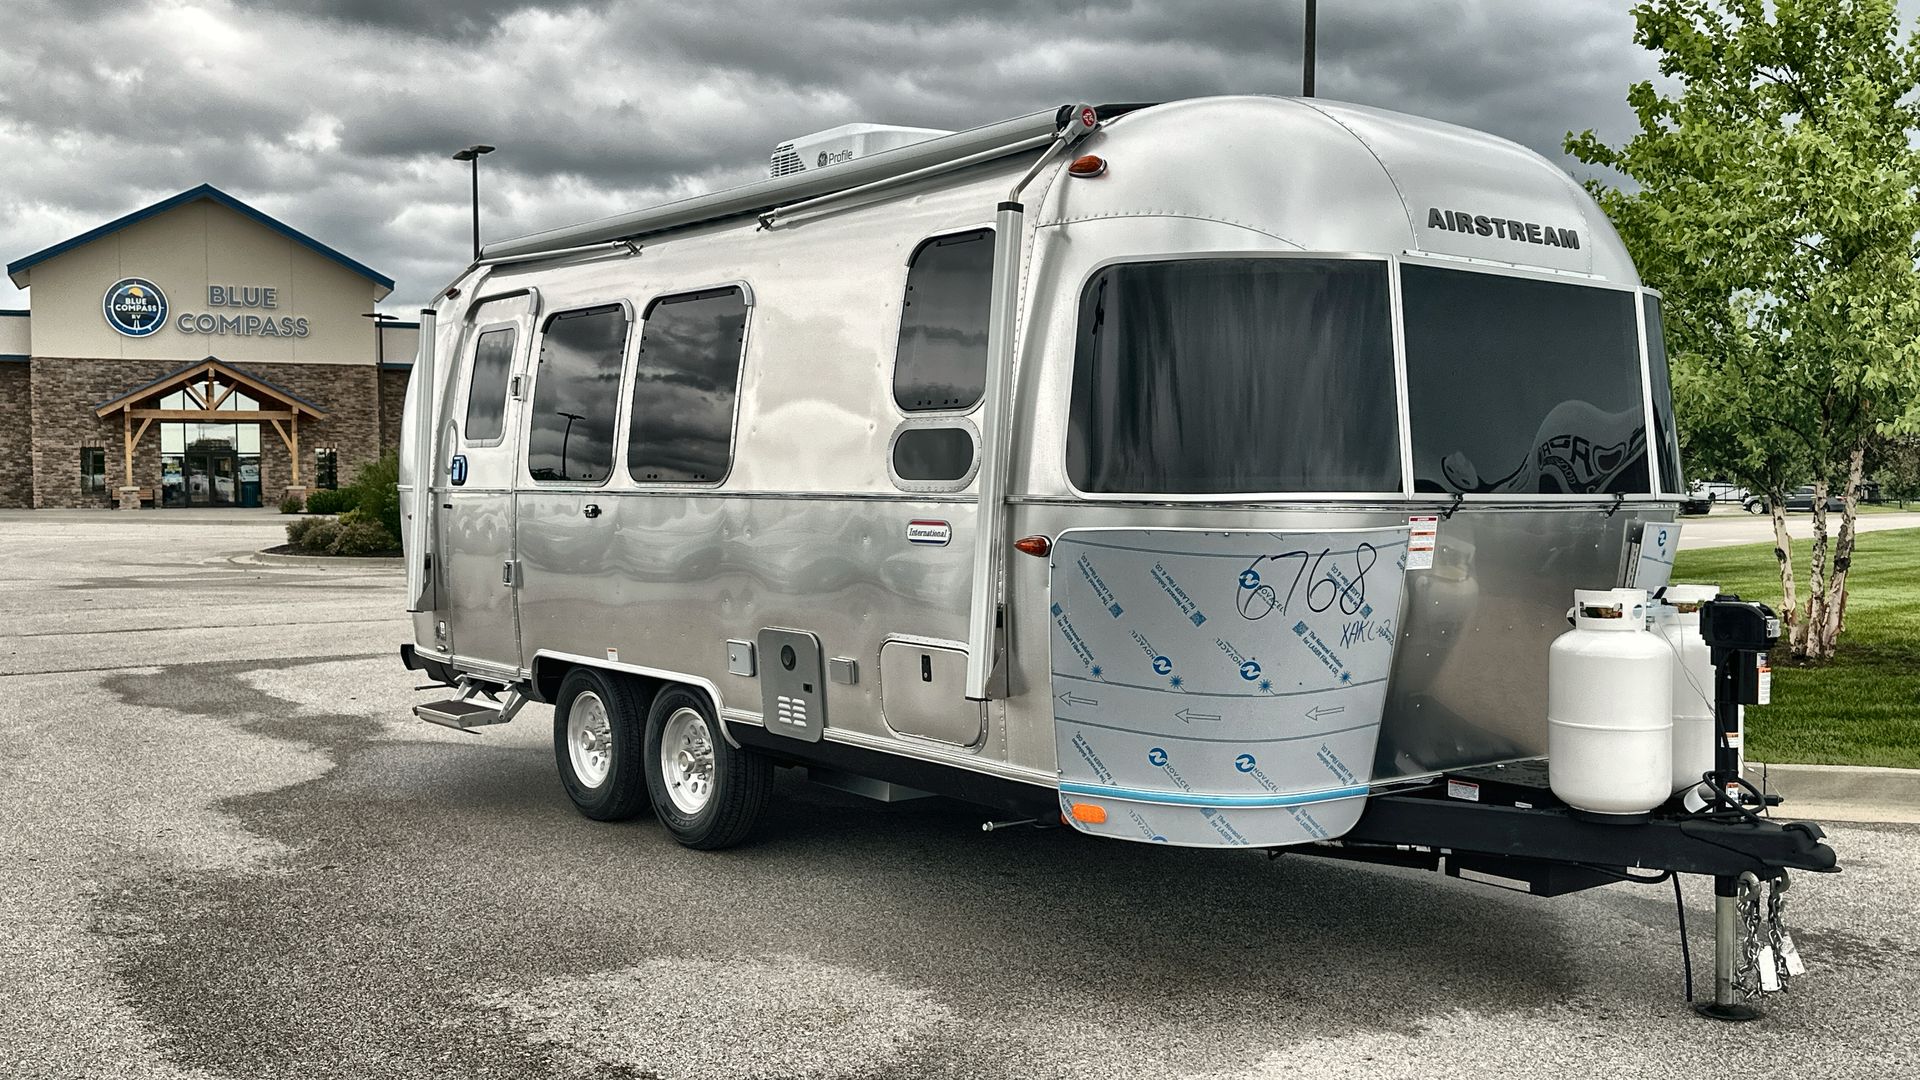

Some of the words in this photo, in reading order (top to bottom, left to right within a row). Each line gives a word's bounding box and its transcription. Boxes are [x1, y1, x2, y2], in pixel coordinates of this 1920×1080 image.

[828, 149, 853, 164] Profile
[1427, 207, 1581, 250] AIRSTREAM
[207, 284, 277, 308] BLUE
[115, 303, 158, 312] COMPASS
[176, 312, 310, 338] COMPASS
[909, 527, 948, 538] International
[1089, 567, 1098, 579] Fiber
[1151, 569, 1167, 588] Solution
[1165, 576, 1176, 588] Fiber
[1236, 542, 1377, 620] 6768
[1088, 579, 1102, 597] Novacel
[1096, 578, 1109, 594] LASER
[1175, 587, 1190, 602] LASER
[1165, 587, 1182, 606] Novacel
[1181, 605, 1189, 615] The
[1061, 626, 1073, 642] LASER
[1071, 642, 1081, 653] Fiber
[1067, 624, 1081, 642] Novacel
[1079, 641, 1094, 661] Solution
[1129, 630, 1158, 659] NOVACEL
[1216, 638, 1244, 666] NOVACEL
[1308, 643, 1322, 657] LASER
[1320, 655, 1329, 665] Fiber
[1315, 638, 1331, 654] Novacel
[1329, 652, 1343, 668] Solution
[1072, 738, 1086, 757] Solution
[1085, 745, 1095, 757] Fiber
[1085, 757, 1100, 775] Novacel
[1094, 757, 1106, 772] LASER
[1329, 754, 1339, 764] Fiber
[1337, 762, 1348, 775] LASER
[1162, 763, 1190, 792] NOVACEL
[1251, 768, 1278, 792] NOVACEL
[1128, 809, 1155, 839] NOVACEL
[1217, 815, 1225, 824] The
[1224, 823, 1242, 839] Novacel
[1217, 826, 1232, 841] LASER
